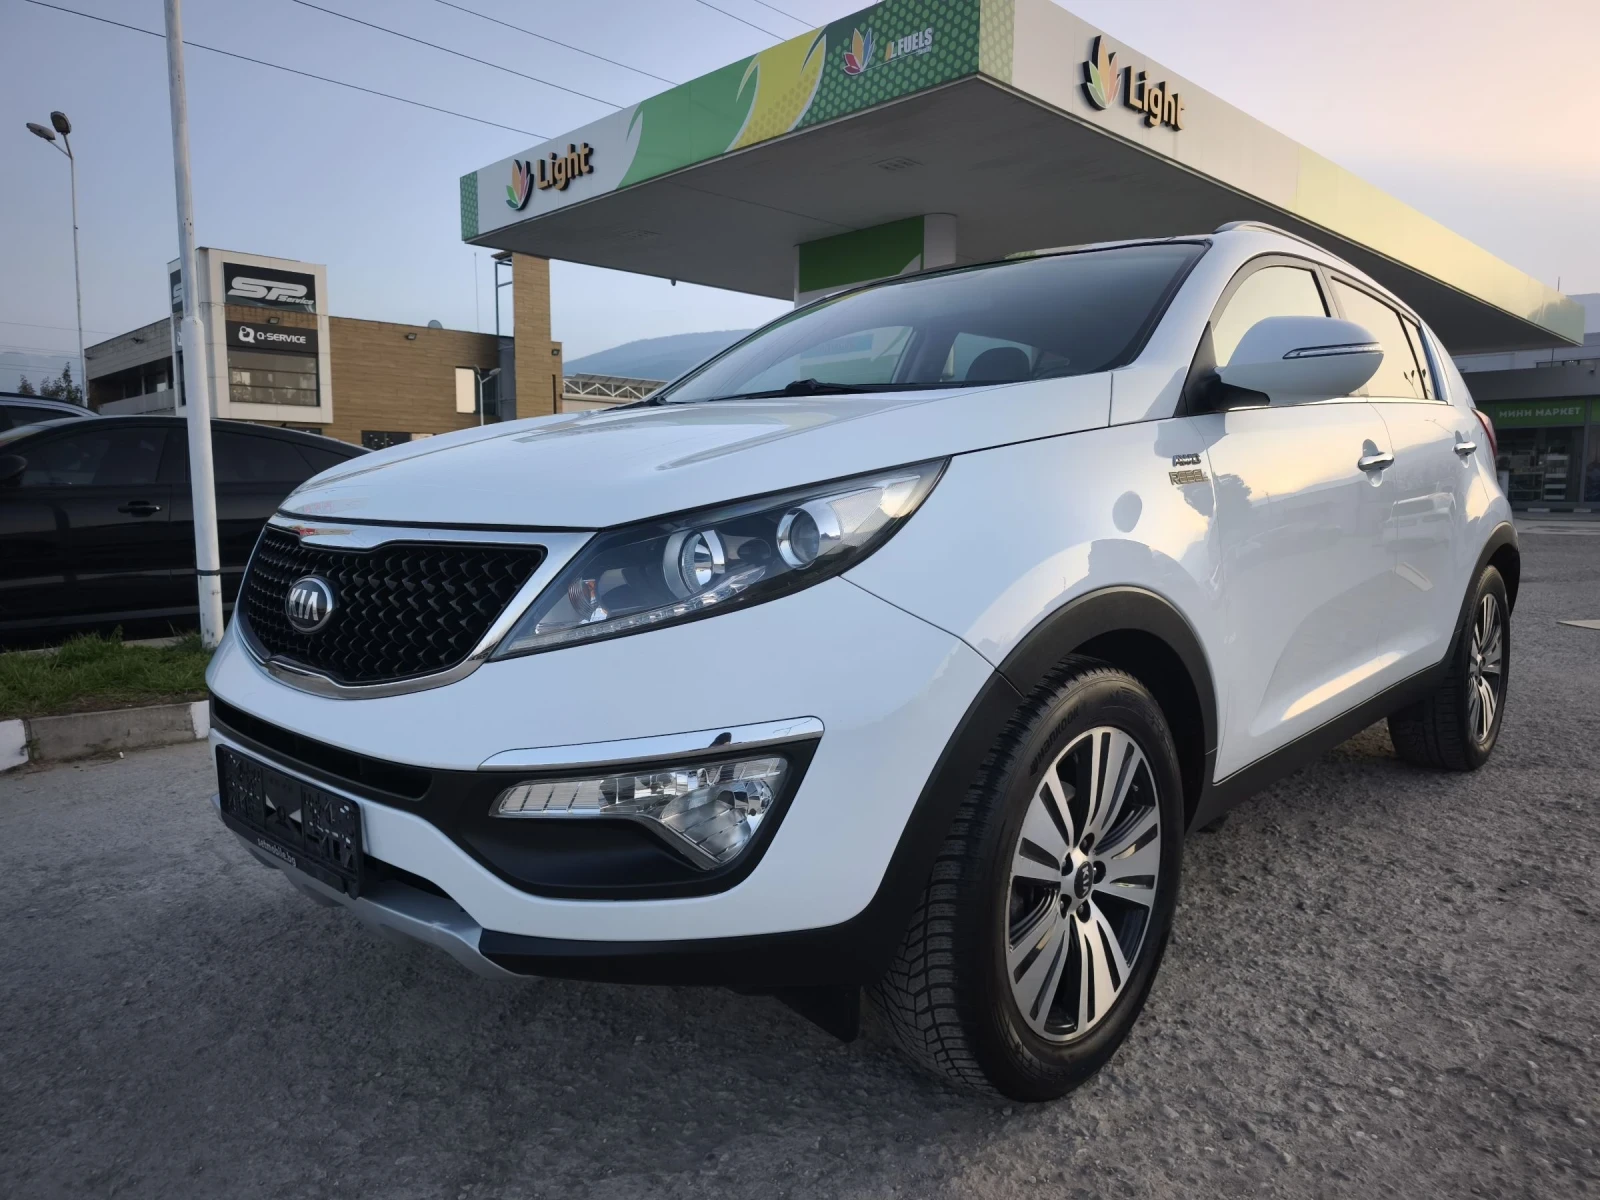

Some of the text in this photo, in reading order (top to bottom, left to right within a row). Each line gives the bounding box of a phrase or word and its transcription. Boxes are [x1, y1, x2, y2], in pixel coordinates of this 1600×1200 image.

[1123, 65, 1185, 132] Light
[536, 142, 594, 191] Light
[227, 276, 308, 301] SP
[277, 295, 315, 305] Service
[1499, 407, 1581, 418] МИНИ МАРКЕТ
[289, 587, 319, 621] KIA
